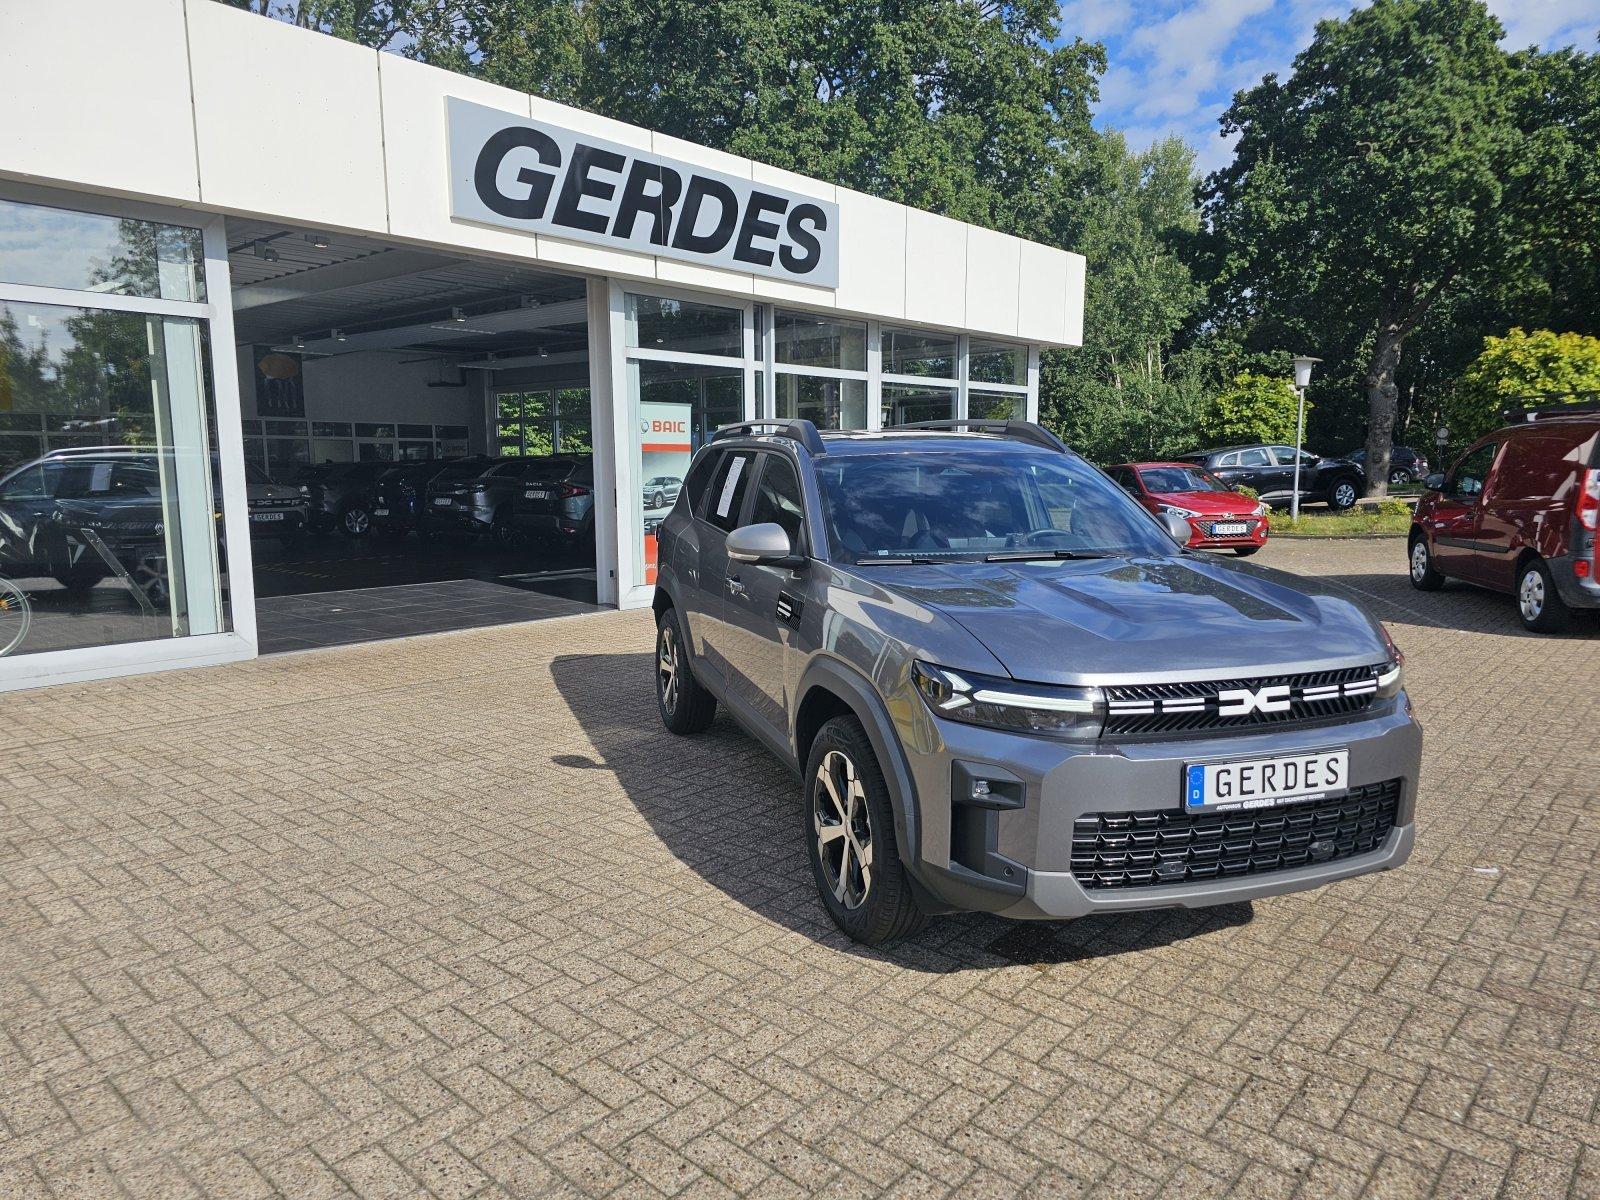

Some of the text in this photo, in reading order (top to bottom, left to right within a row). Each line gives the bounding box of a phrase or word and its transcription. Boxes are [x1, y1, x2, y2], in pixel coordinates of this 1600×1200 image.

[474, 126, 828, 275] GERDES
[652, 420, 686, 433] BAIC
[256, 513, 282, 521] GERDES
[1215, 757, 1339, 798] GERDES
[1192, 789, 1200, 799] D
[1242, 797, 1275, 810] GERDES
